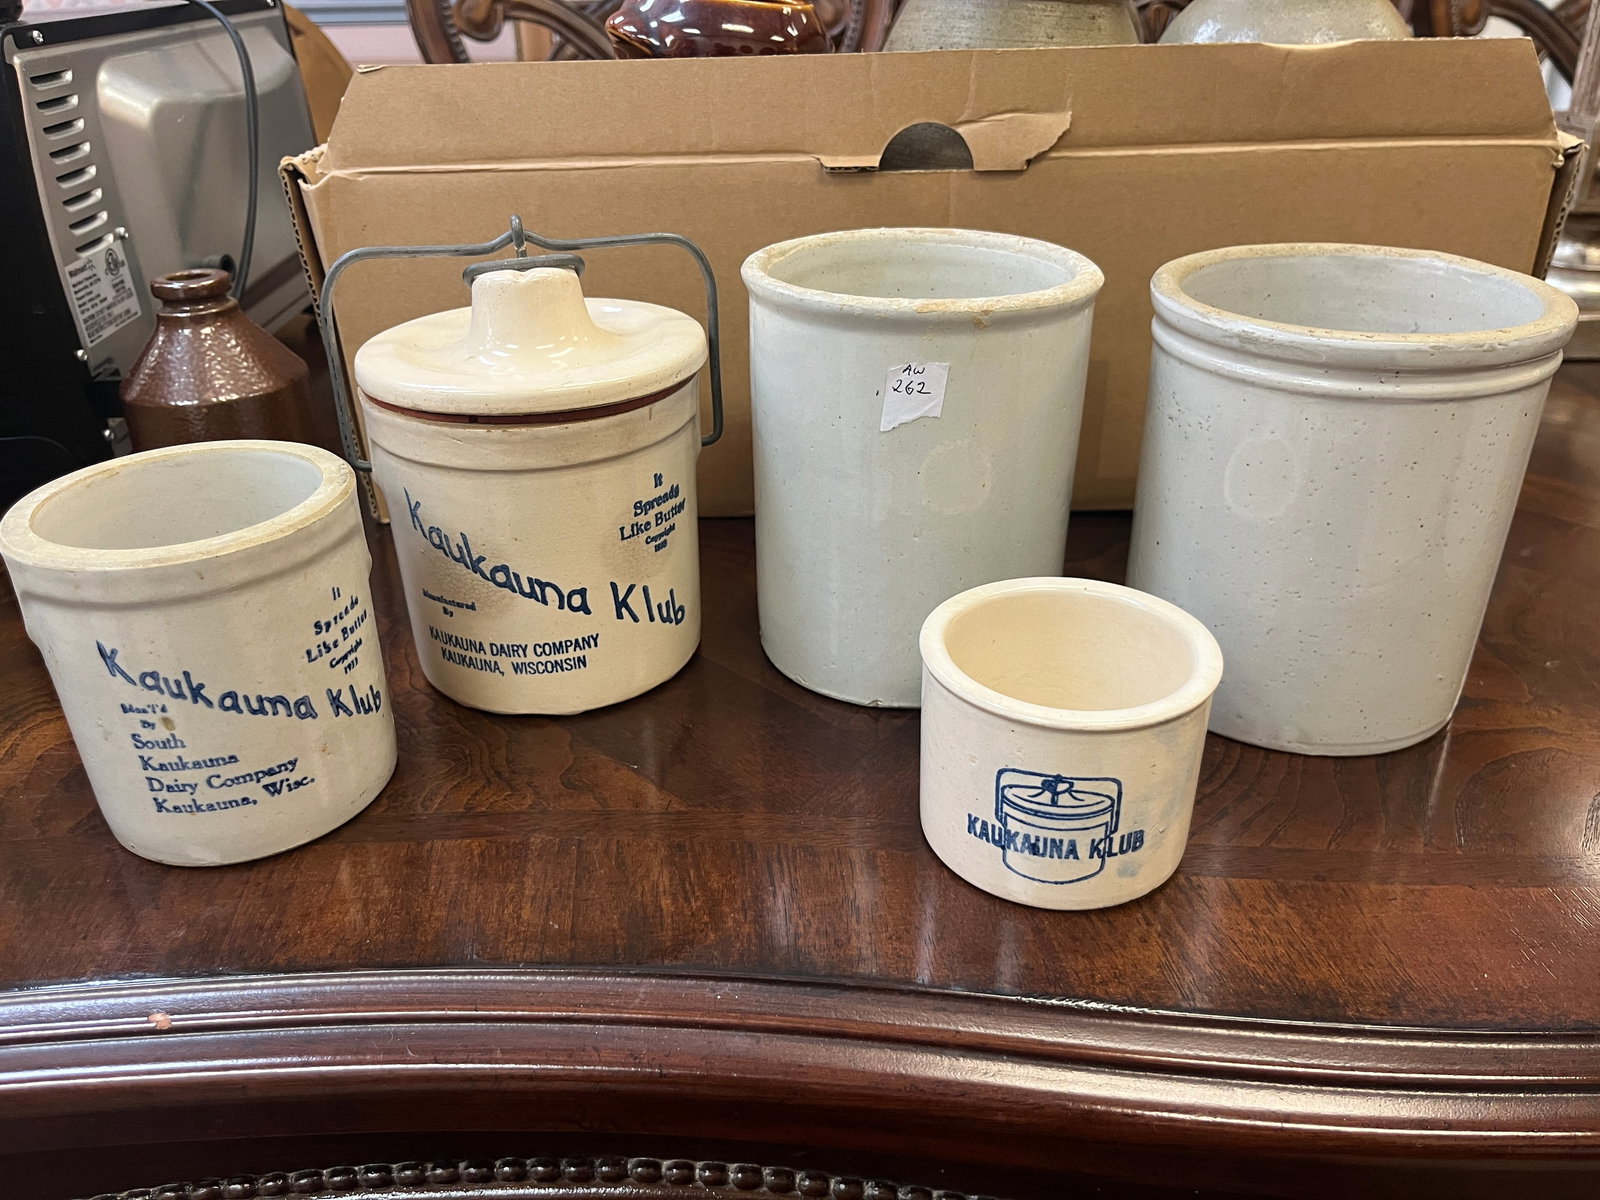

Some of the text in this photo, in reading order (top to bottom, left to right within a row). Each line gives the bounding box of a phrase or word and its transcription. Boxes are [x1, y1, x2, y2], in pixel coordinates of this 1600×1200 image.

[891, 379, 932, 396] 262
[902, 364, 926, 376] AW
[653, 472, 664, 489] It
[633, 483, 680, 518] Spreads
[619, 497, 686, 541] Like Butter
[403, 486, 686, 626] Kaukauna Klub
[313, 594, 359, 636] Spreads
[306, 608, 367, 663] Like Butter
[429, 625, 600, 659] KAUKAUNA DAIRY COMPANY
[440, 645, 588, 677] KAUKAUNA, WISCONSIN
[96, 640, 382, 721] Kaukauna Klub
[131, 732, 187, 750] South
[138, 754, 240, 772] Kaukauna
[146, 757, 299, 795] Dairy Company
[153, 776, 316, 814] Kaukauna, Wisc.
[967, 812, 1145, 861] KAUKAUNA KLUB
